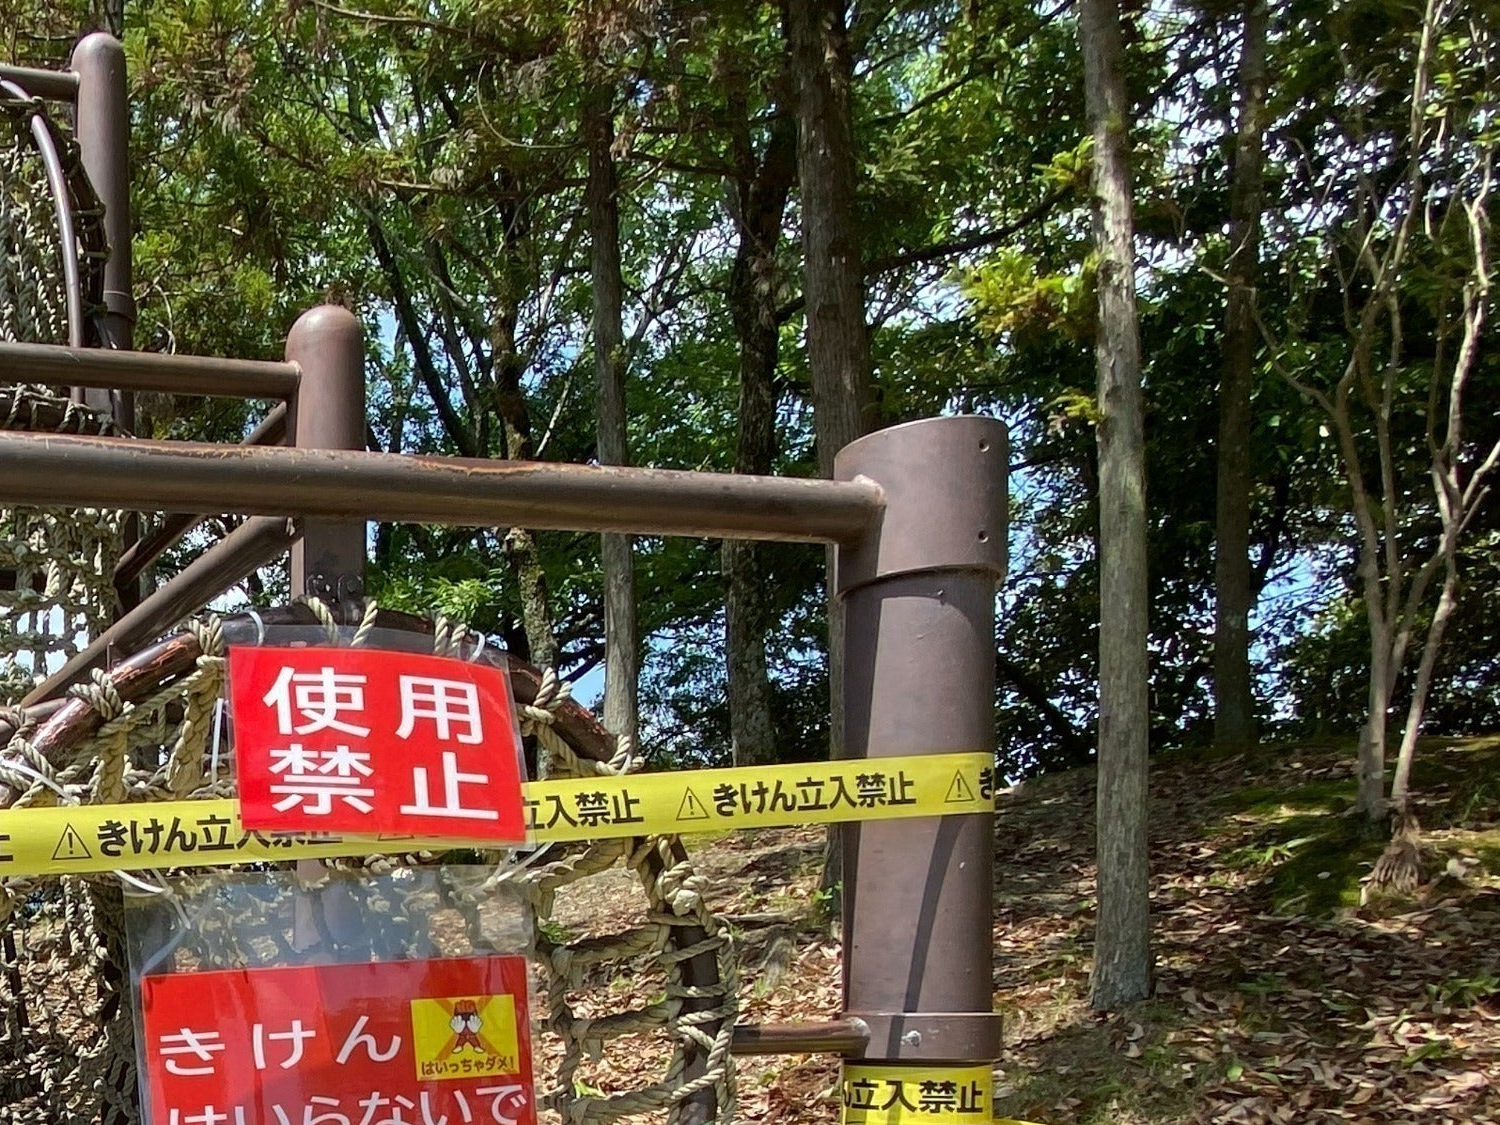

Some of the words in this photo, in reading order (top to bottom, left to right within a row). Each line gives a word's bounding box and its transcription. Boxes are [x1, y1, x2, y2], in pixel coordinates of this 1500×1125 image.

[263, 666, 483, 744] 使用
[268, 743, 498, 820] 禁止
[712, 770, 917, 818] きけん立入禁止
[159, 1015, 402, 1076] きけん
